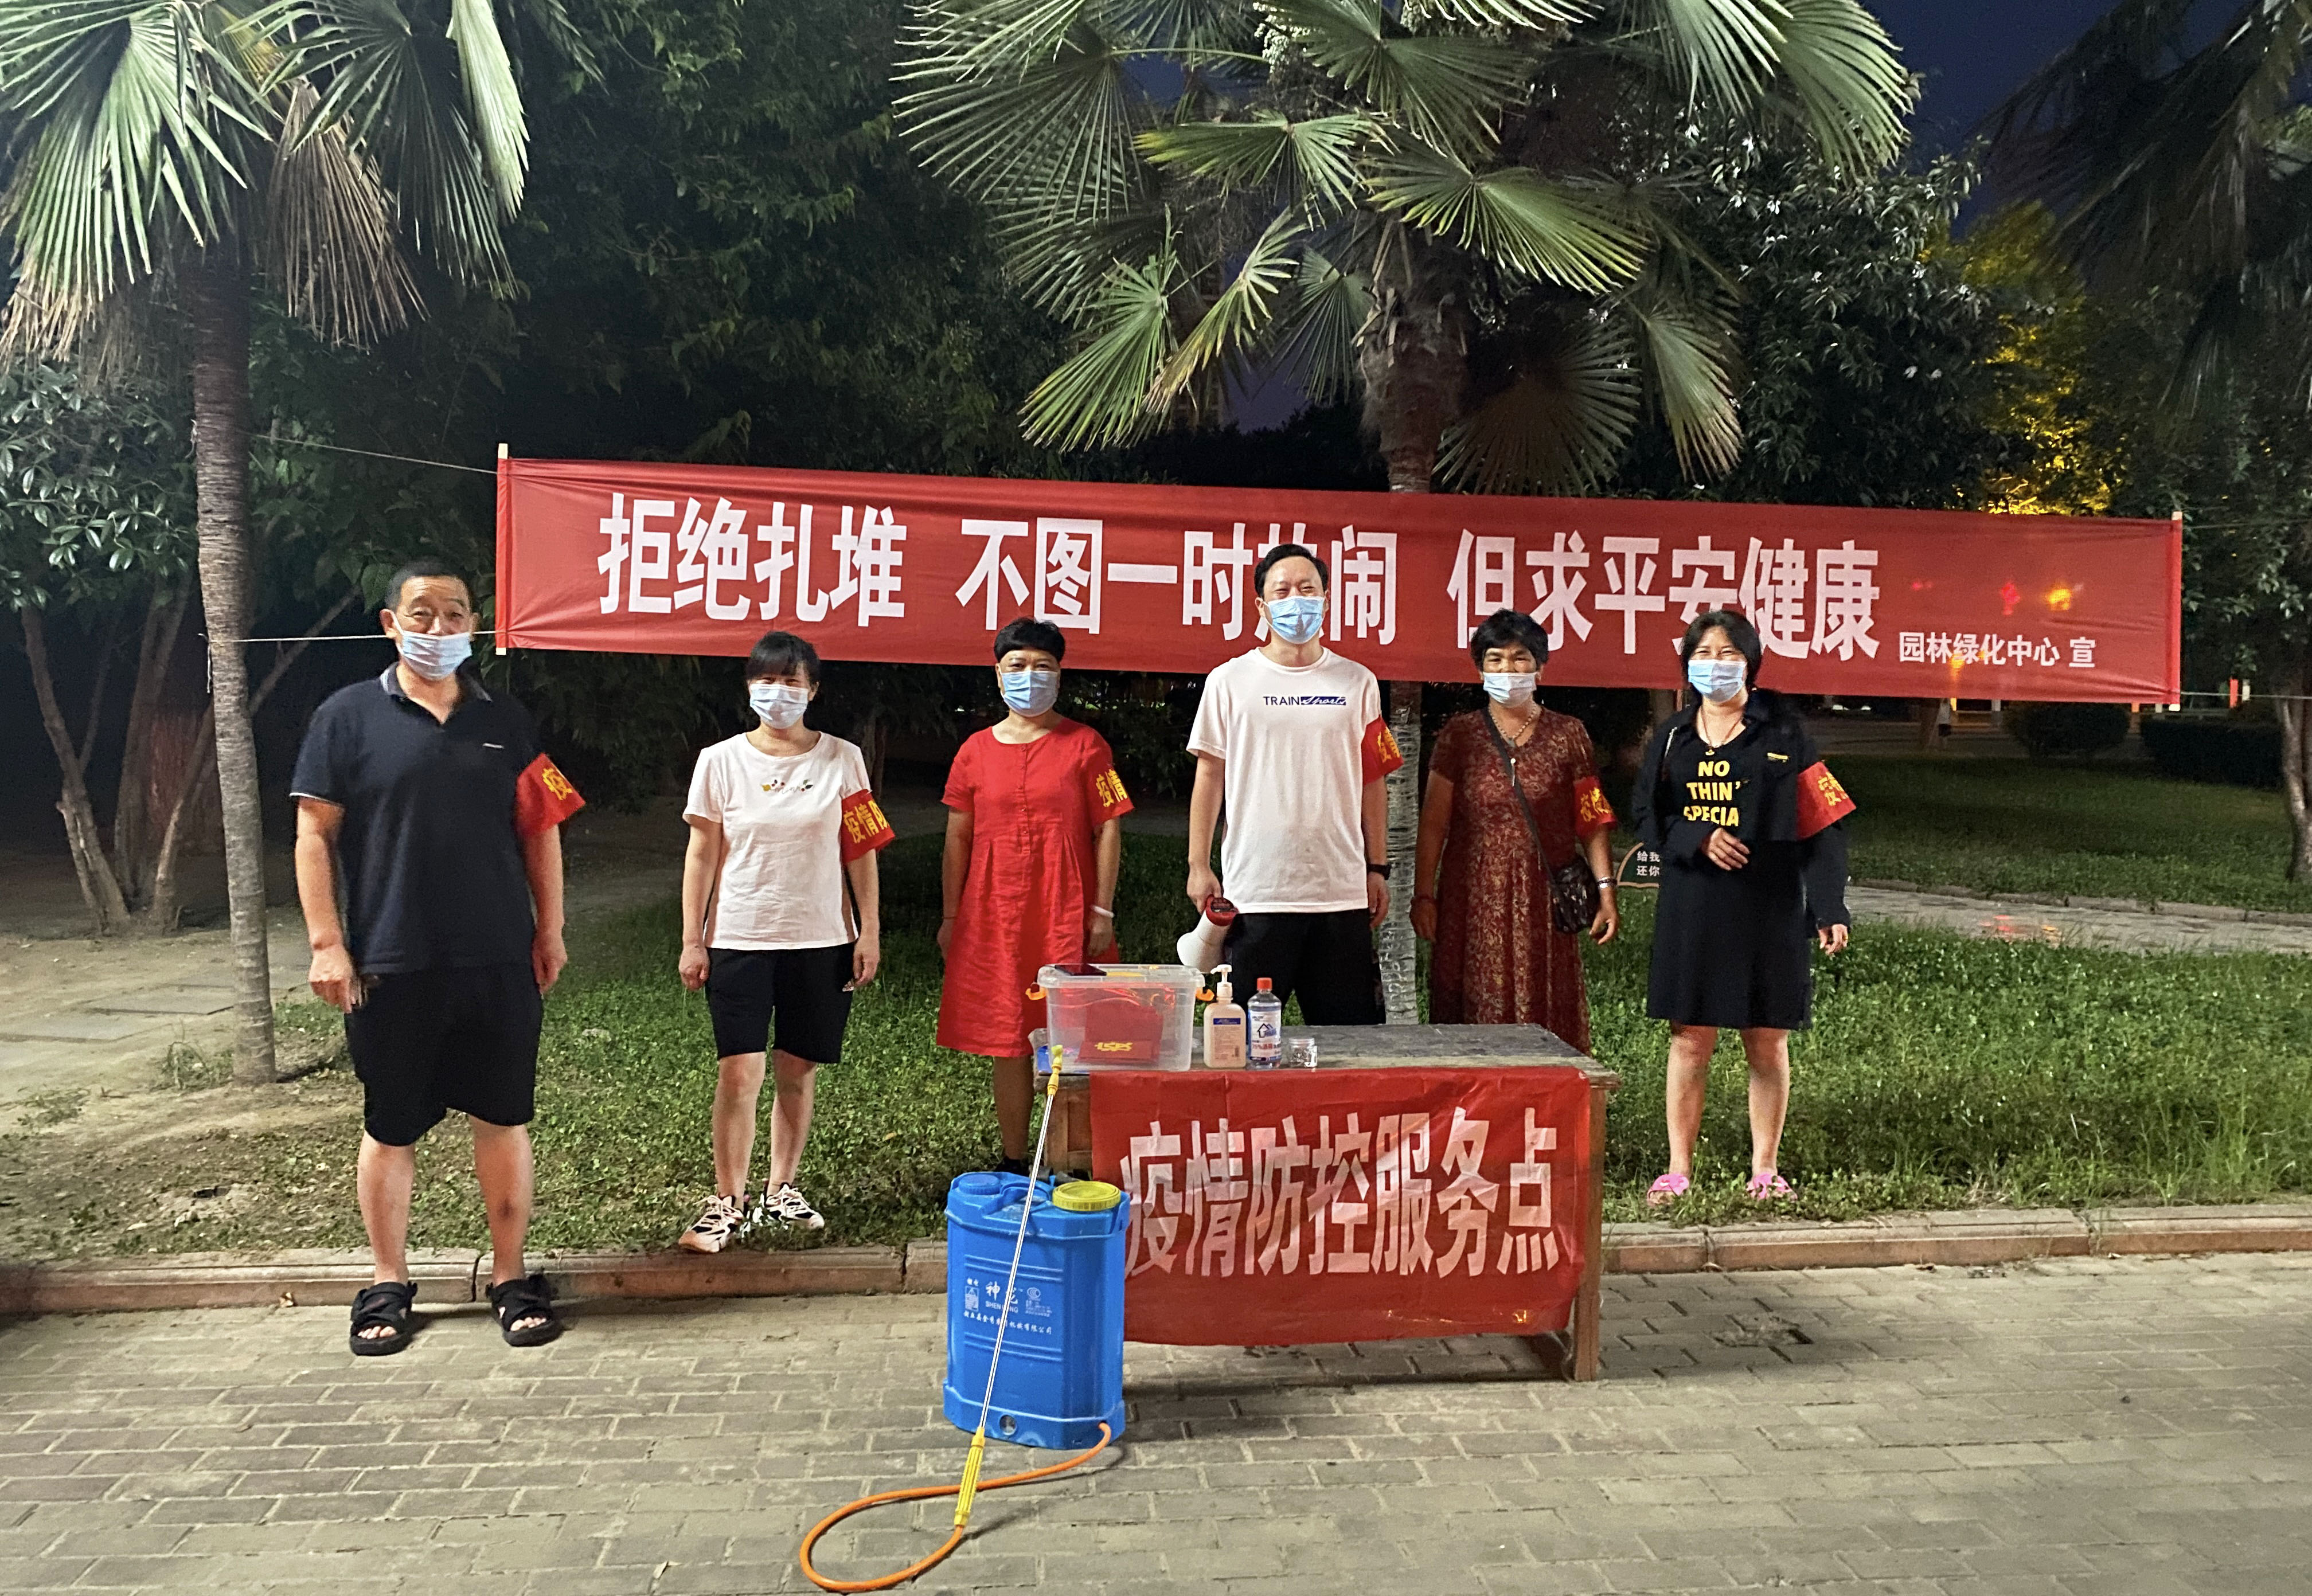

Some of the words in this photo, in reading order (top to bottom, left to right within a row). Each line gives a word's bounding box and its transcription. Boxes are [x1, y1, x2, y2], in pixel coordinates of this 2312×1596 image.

[597, 492, 907, 627] 拒绝扎堆
[1446, 529, 1880, 661] 但求平安健康
[1899, 632, 2060, 667] 园林绿化中心
[2068, 636, 2096, 668] 宣
[1698, 760, 1730, 777] NO
[1096, 769, 1128, 807] 疫情
[1686, 781, 1741, 801] THIN'
[1636, 865, 1661, 877] 还你
[1120, 1106, 1560, 1279] 疫情防控服务点
